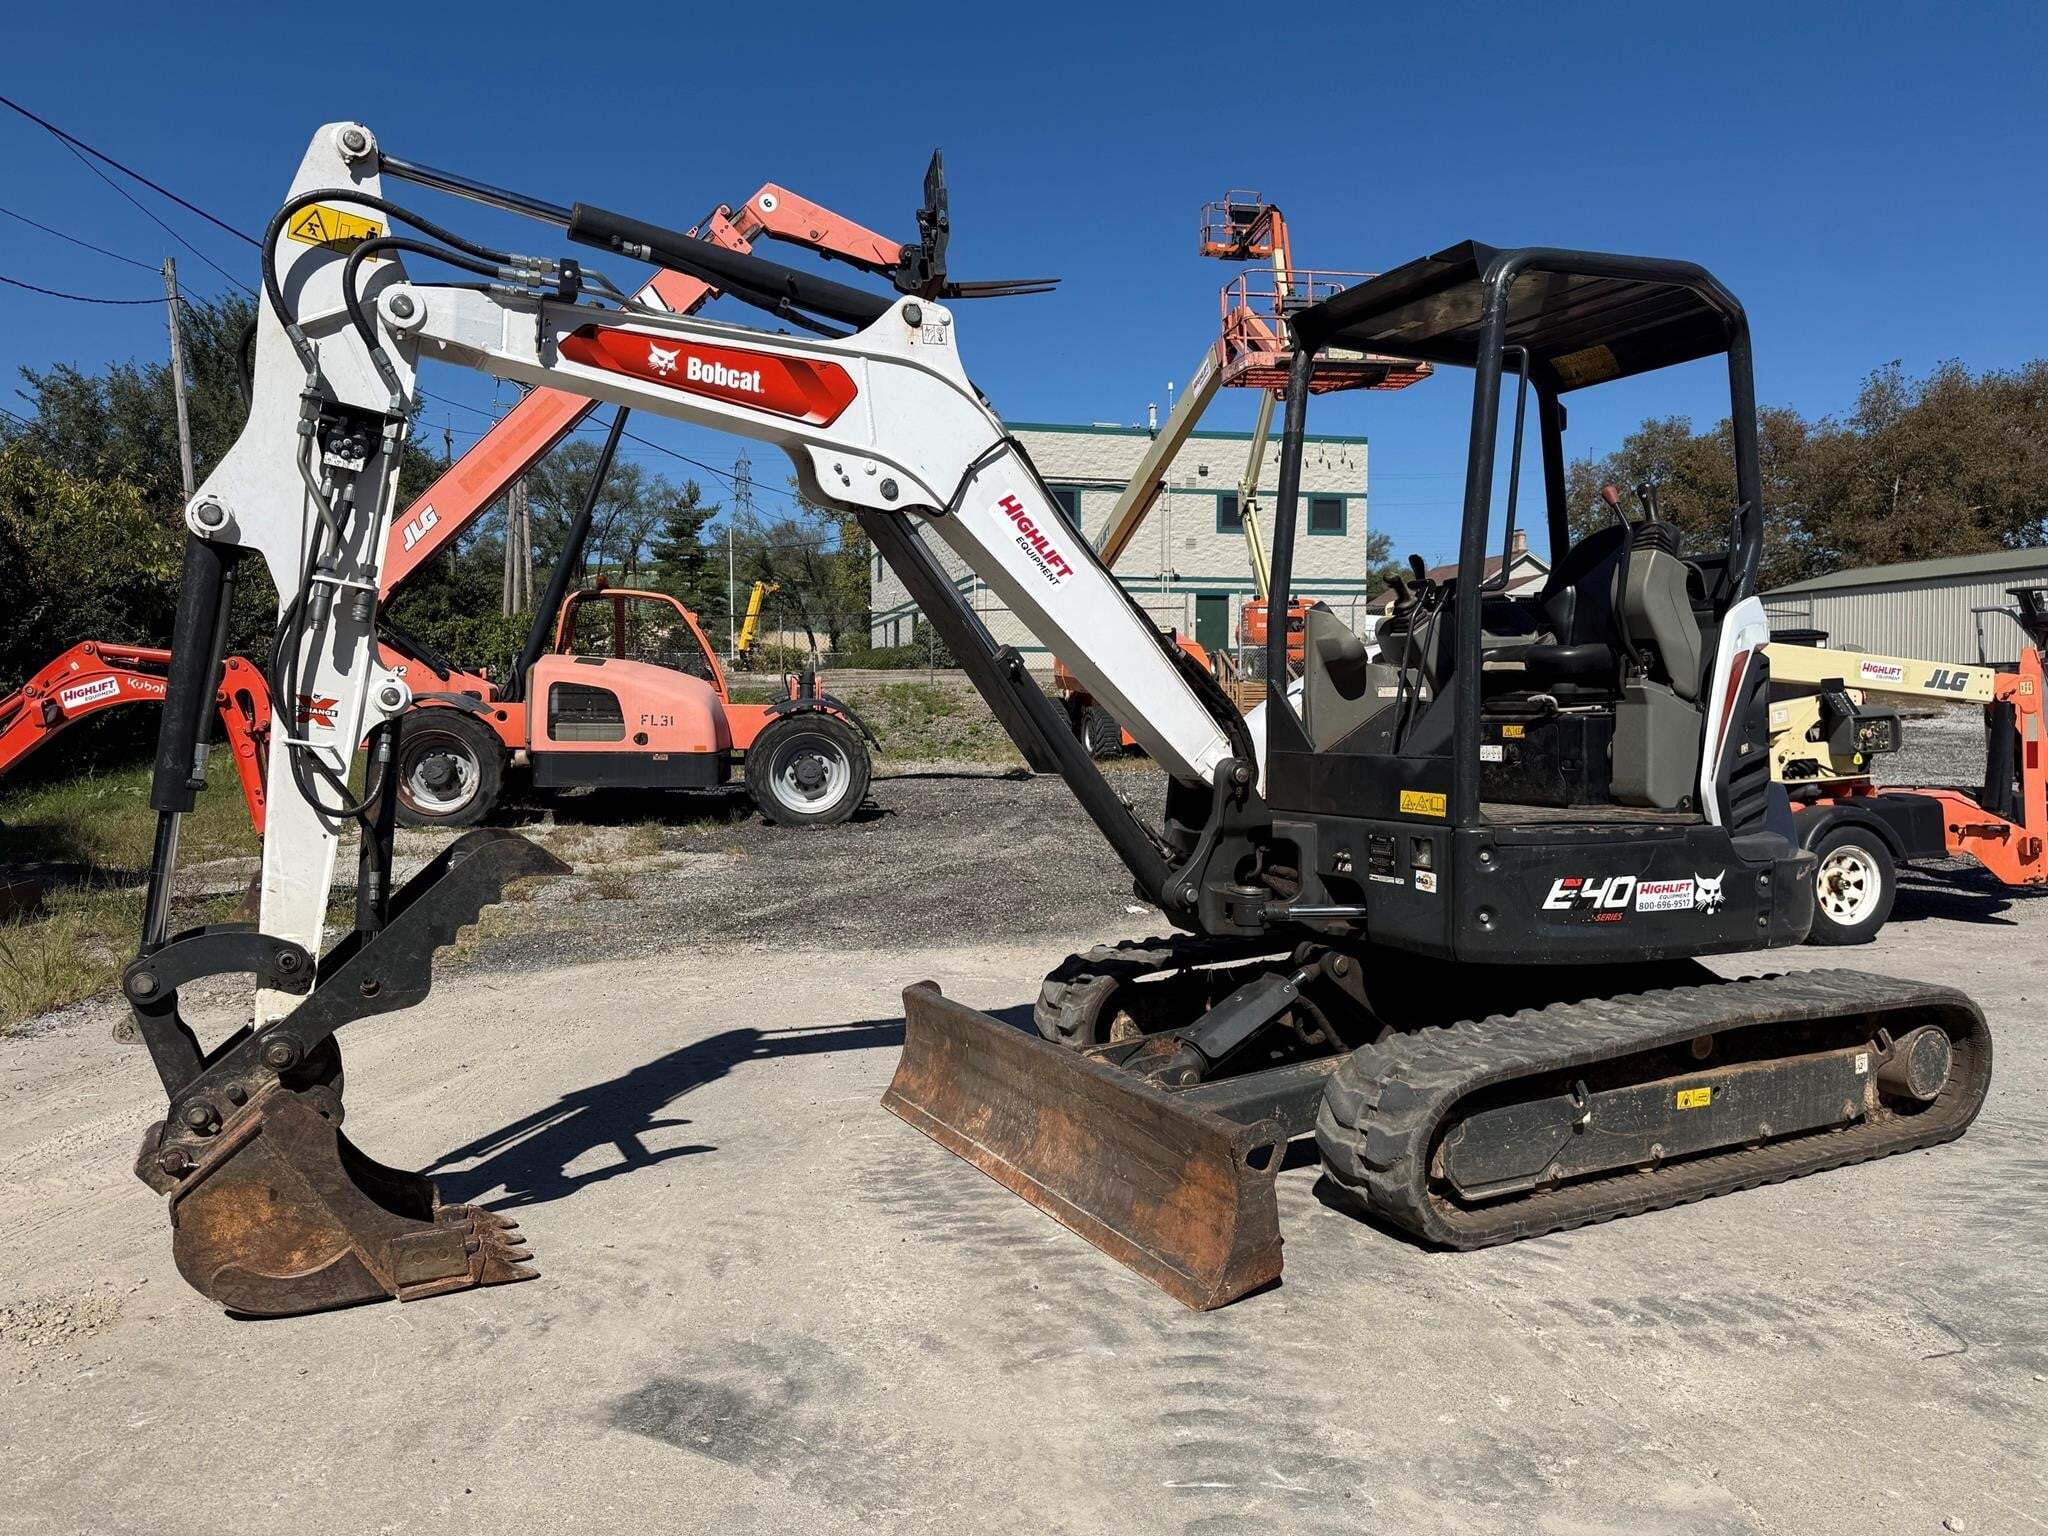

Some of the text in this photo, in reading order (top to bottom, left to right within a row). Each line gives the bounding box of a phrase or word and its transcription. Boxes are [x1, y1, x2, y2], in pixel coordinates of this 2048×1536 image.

[763, 198, 773, 208] 6
[686, 355, 762, 394] Bobcat
[402, 503, 440, 553] JLG
[997, 494, 1074, 578] HIGHLIFT
[1015, 536, 1061, 586] EQUIPMENT
[1861, 662, 1902, 676] HIGHLIFT
[1923, 668, 1970, 692] JLG
[63, 680, 115, 702] HIGHLIFT
[84, 688, 116, 702] EQUIPMENT
[640, 714, 674, 727] FL31
[1541, 875, 1637, 910] E40
[1639, 882, 1692, 895] HIGHLIFT
[1658, 892, 1690, 900] EQUIPMENT
[1638, 899, 1691, 911] 800-696-9517
